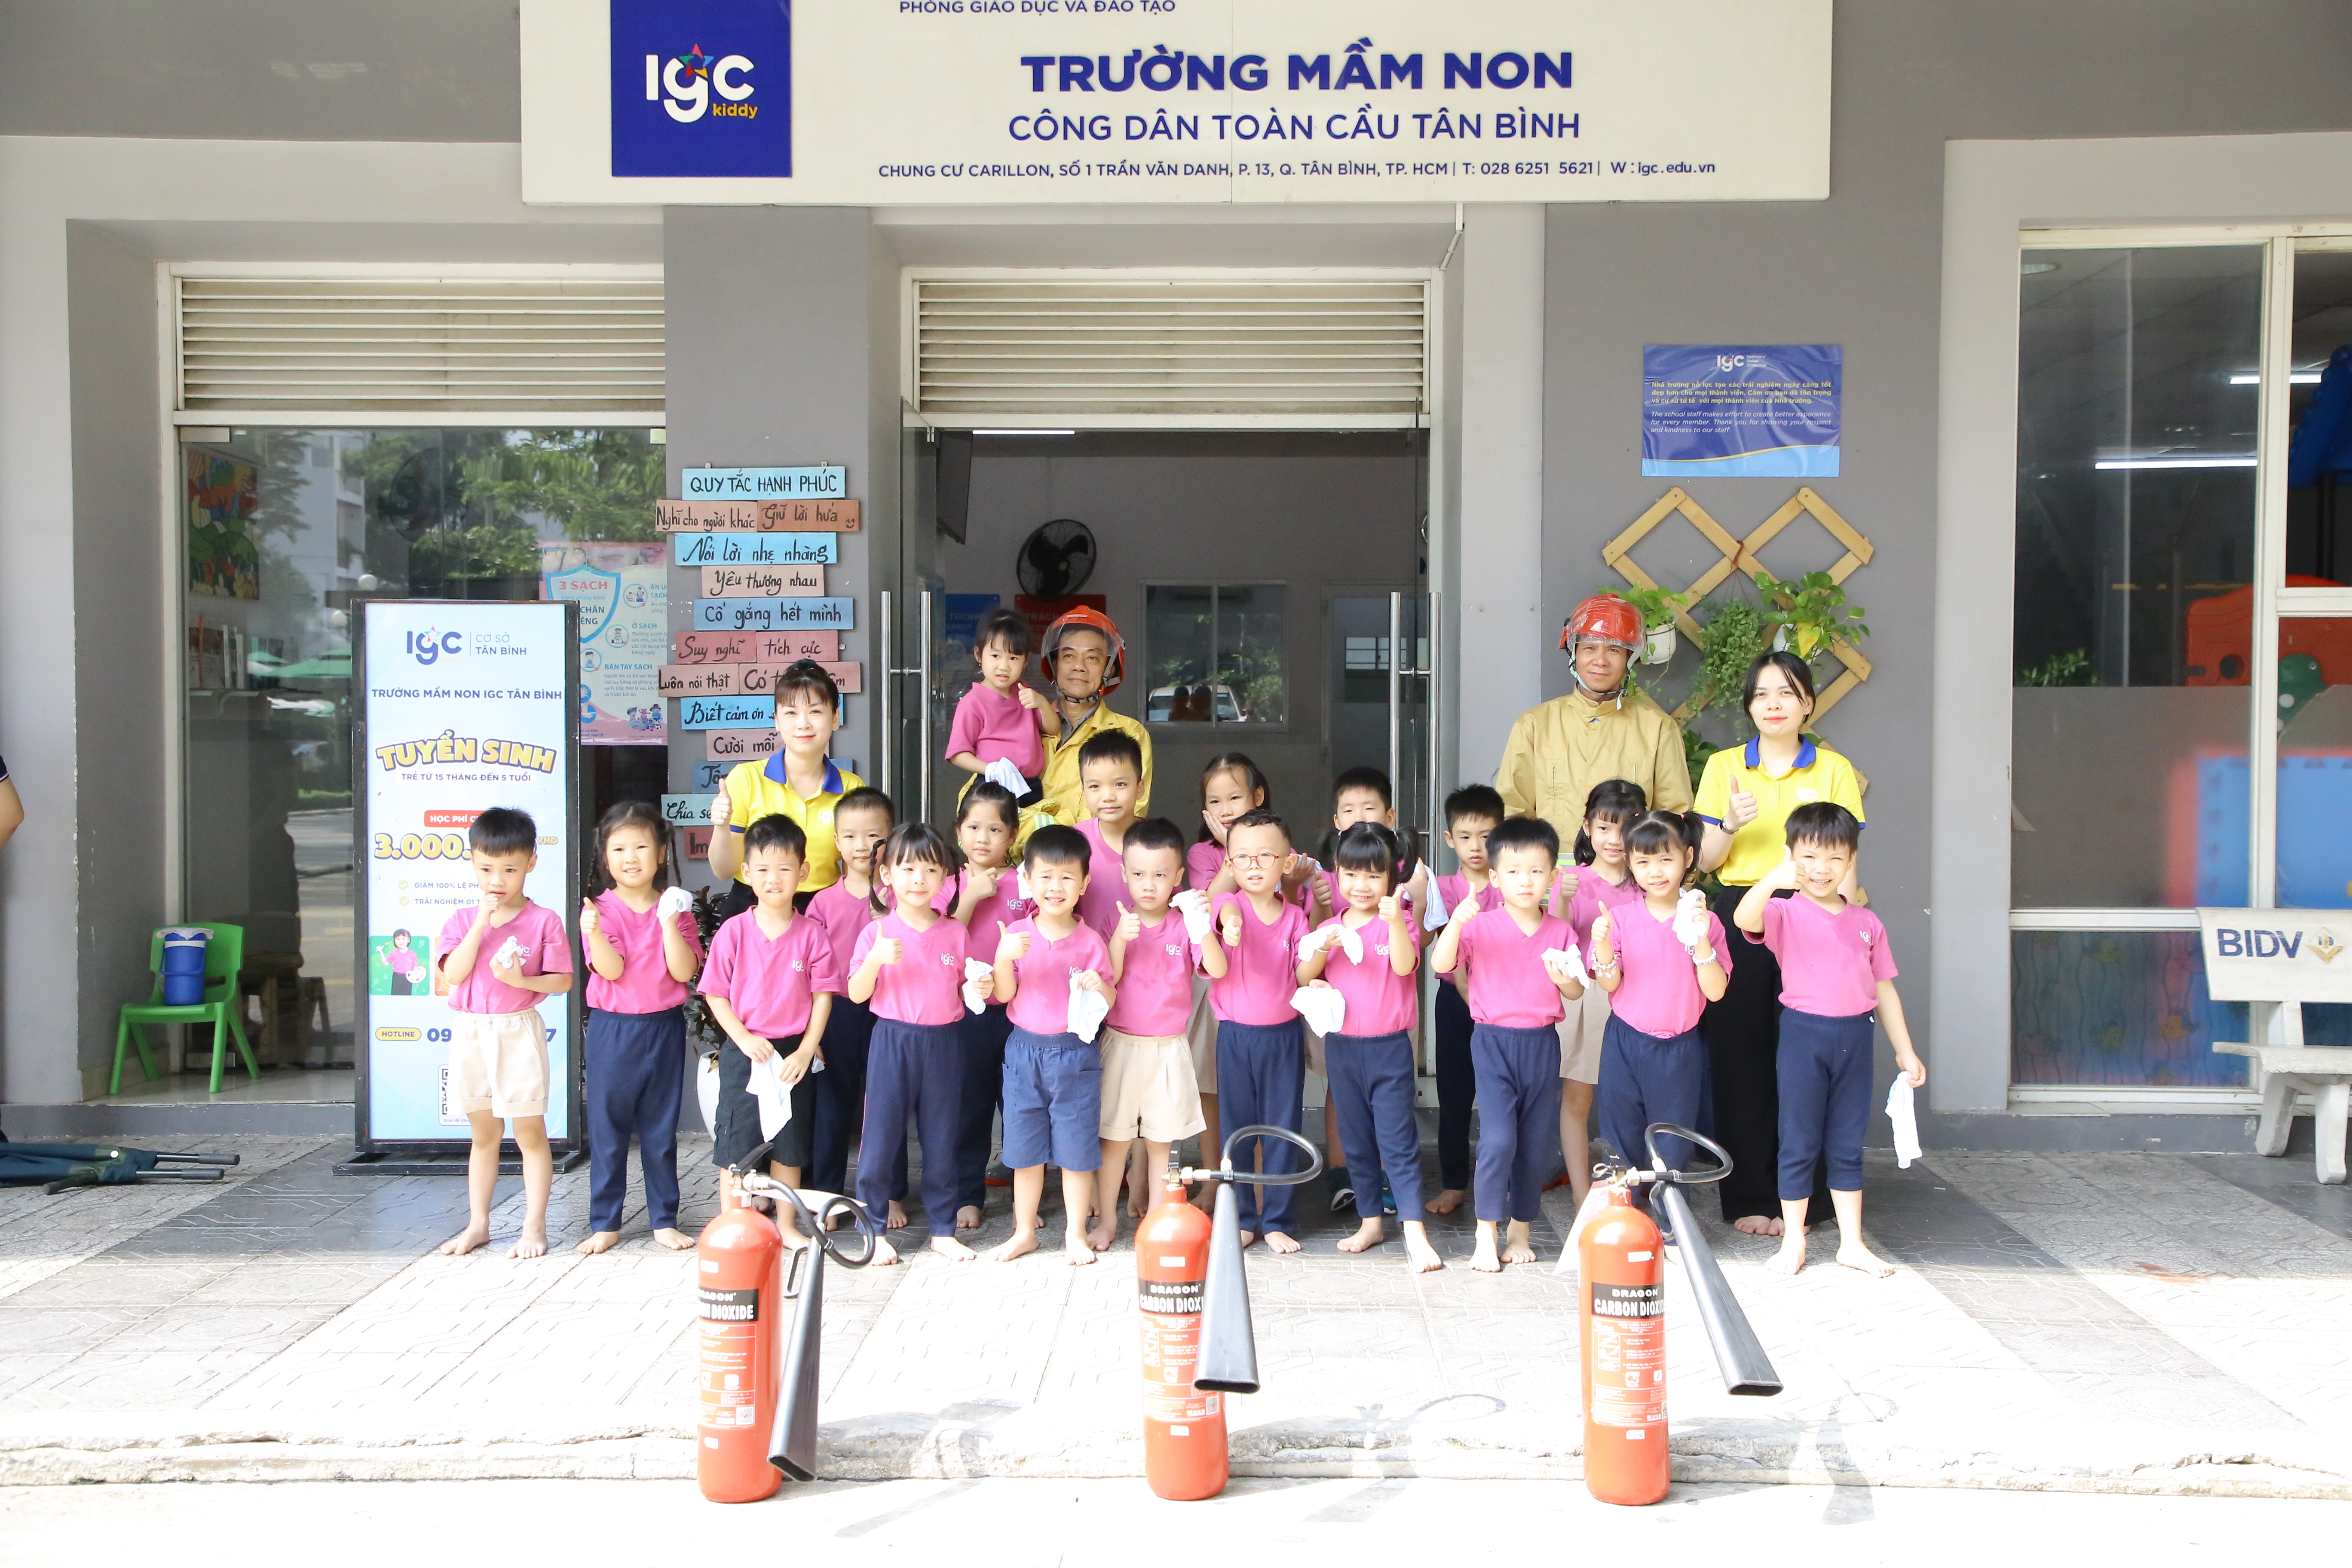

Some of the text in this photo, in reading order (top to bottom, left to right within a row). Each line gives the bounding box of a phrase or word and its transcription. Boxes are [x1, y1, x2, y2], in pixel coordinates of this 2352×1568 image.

[1022, 1, 1059, 16] DỤC
[1021, 37, 1572, 92] TRƯỜNG MẦM NON
[712, 103, 758, 119] kiddy
[1009, 103, 1580, 141] CÔNG DÂN TOÀN CẦU TÂN BÌNH
[879, 165, 936, 178] CHUNG
[941, 164, 964, 177] CƯ
[969, 165, 1054, 178] CARILLON,
[1060, 160, 1081, 176] SỐ
[1087, 165, 1091, 176] 1
[1097, 159, 1140, 176] TRẦN
[1146, 161, 1178, 176] VĂN
[1184, 164, 1233, 178] DANH,
[1240, 164, 1250, 176] P.
[1256, 164, 1274, 178] 13,
[1280, 164, 1295, 176] Q.
[1302, 161, 1332, 175] TÂN
[1339, 161, 1381, 177] BÌNH,
[1386, 163, 1408, 175] TP.
[1414, 163, 1448, 175] HCM
[1463, 163, 1475, 175] T:
[1481, 163, 1510, 175] 028
[1516, 163, 1549, 175] 6251
[690, 469, 837, 496] QUY TẮC HẠNH PHÚC
[656, 506, 683, 530] Nghĩ
[683, 507, 698, 526] cho
[731, 508, 755, 529] khác
[761, 503, 838, 530] Giữ lời hứa
[683, 536, 829, 564] Nói lời nhẹ nhàng
[559, 581, 608, 592] 3 SẠCH
[710, 569, 817, 596] Yêu thương nhau
[580, 605, 604, 613] CHÂN
[705, 602, 842, 630] Cố gắng hết mình
[475, 631, 510, 643] CƠ SỞ
[475, 644, 527, 655] TÂN BÌNH
[679, 636, 707, 663] Suy
[716, 638, 745, 662] nghĩ
[764, 638, 790, 657] tích
[801, 640, 822, 659] cực
[658, 670, 683, 690] Luôn
[689, 675, 702, 689] nói
[706, 671, 731, 692] thật
[744, 668, 767, 691] Có
[371, 686, 562, 700] TRƯỜNG MẦM NON IGC TÂN BÌNH
[684, 700, 764, 725] Biết cảm ơn
[376, 729, 557, 774] TUYỂN SINH
[714, 732, 778, 754] Cười mỗi
[401, 771, 418, 781] TRẺ
[420, 772, 432, 781] TỪ
[447, 772, 478, 781] THÁNG
[480, 771, 499, 781] ĐẾN
[509, 771, 531, 781] TUỔI
[430, 815, 450, 825] HỌC
[452, 814, 468, 823] PHÍ
[667, 800, 695, 820] Chia
[536, 836, 558, 845] VND
[458, 881, 466, 890] LỆ
[434, 897, 463, 906] NGHIỆM
[2217, 928, 2303, 959] BIDV
[1150, 1284, 1198, 1294] DRAGON
[1612, 1289, 1658, 1297] DRAGON
[712, 1304, 753, 1320] DIOXIDE
[1140, 1293, 1174, 1313] CARBON
[1594, 1298, 1638, 1316] CARBON
